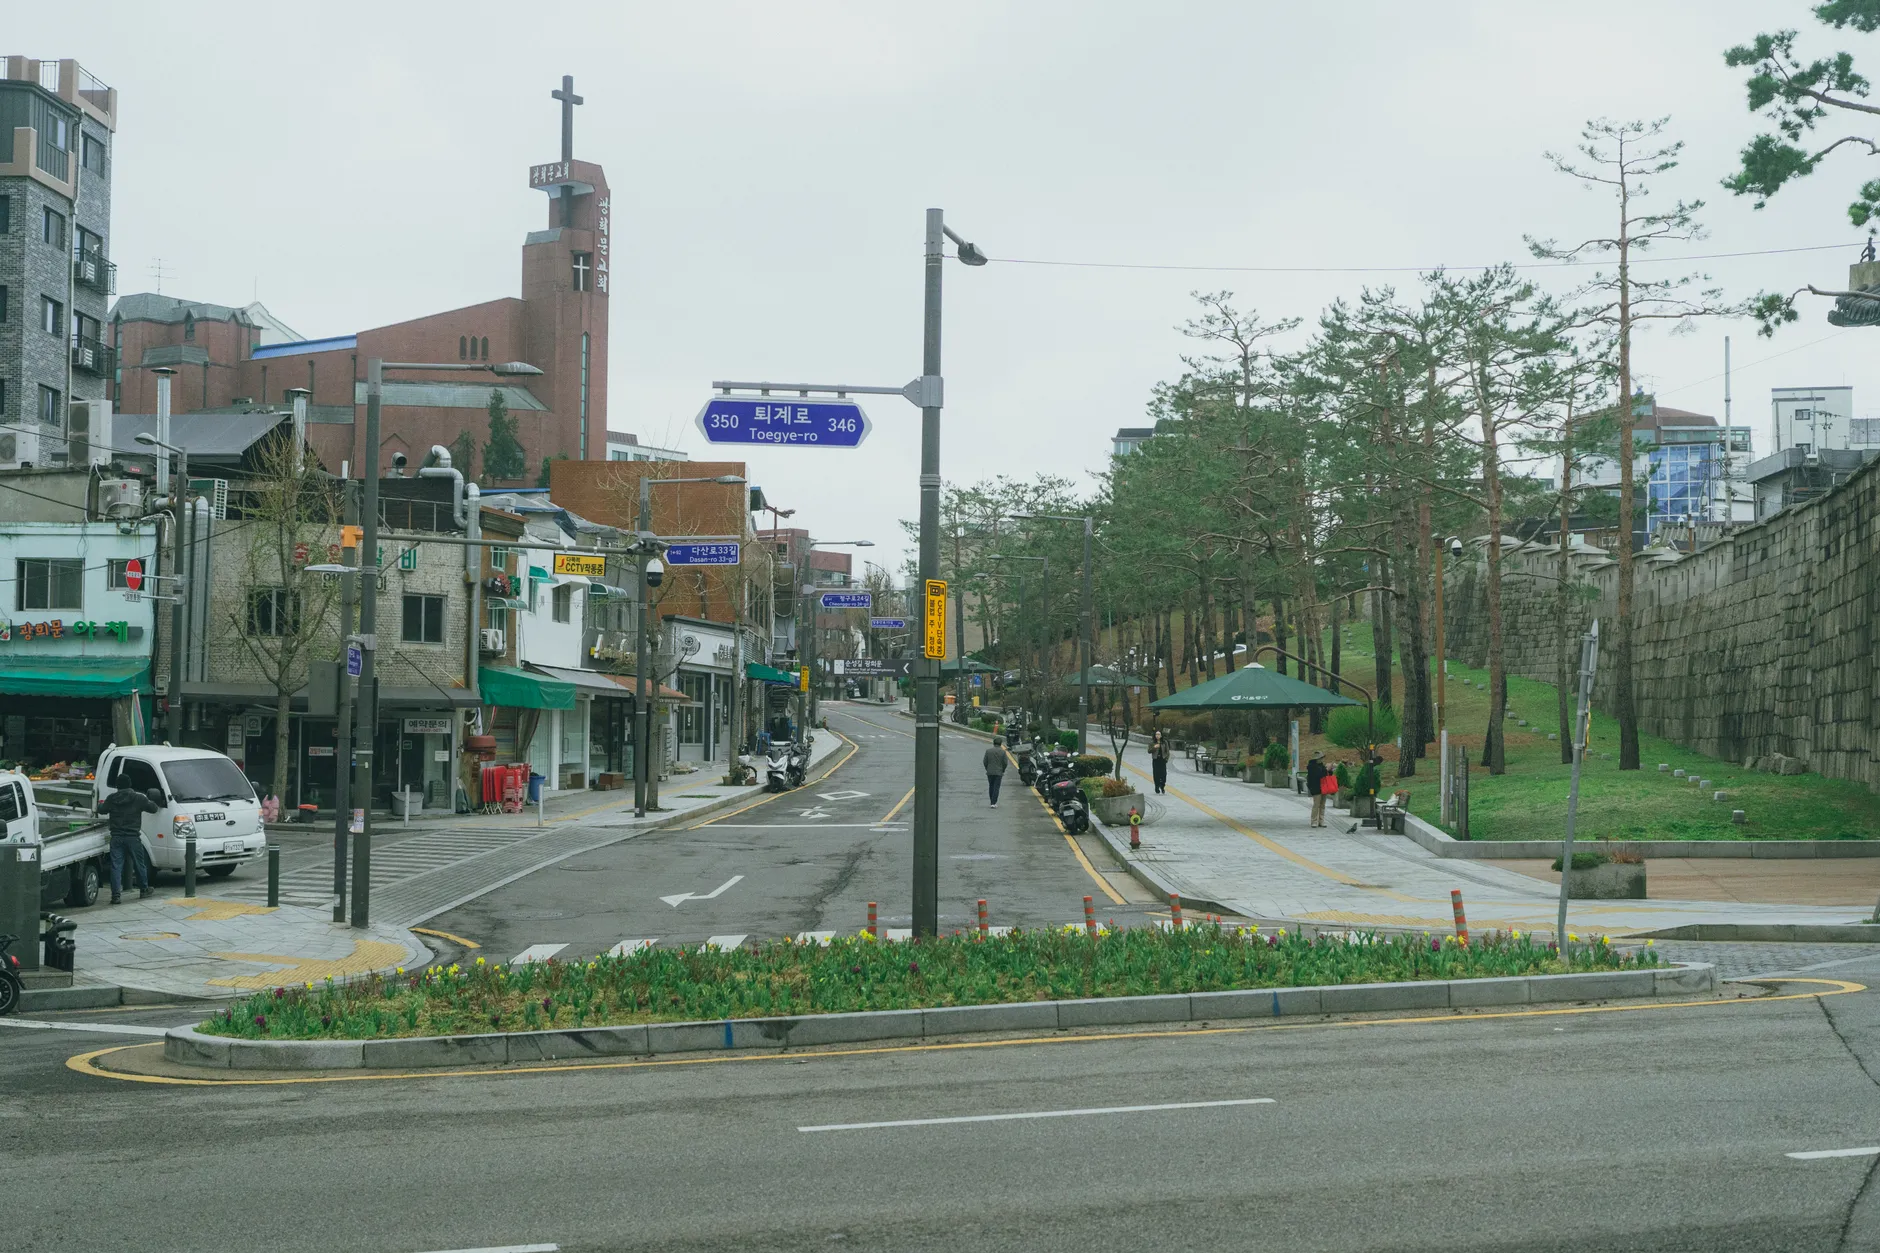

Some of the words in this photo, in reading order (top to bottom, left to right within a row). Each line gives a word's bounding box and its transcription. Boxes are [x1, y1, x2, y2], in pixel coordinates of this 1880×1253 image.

[710, 414, 739, 429] 350
[753, 405, 812, 425] 퇴계로
[827, 418, 856, 433] 346
[749, 428, 818, 443] Toegye-ro
[691, 546, 736, 556] 다산로33길
[718, 556, 736, 564] 33-gil
[566, 563, 604, 575] CCTV작동중
[20, 619, 64, 641] 광희문
[73, 621, 129, 643] 야채
[408, 720, 447, 729] 예약문의
